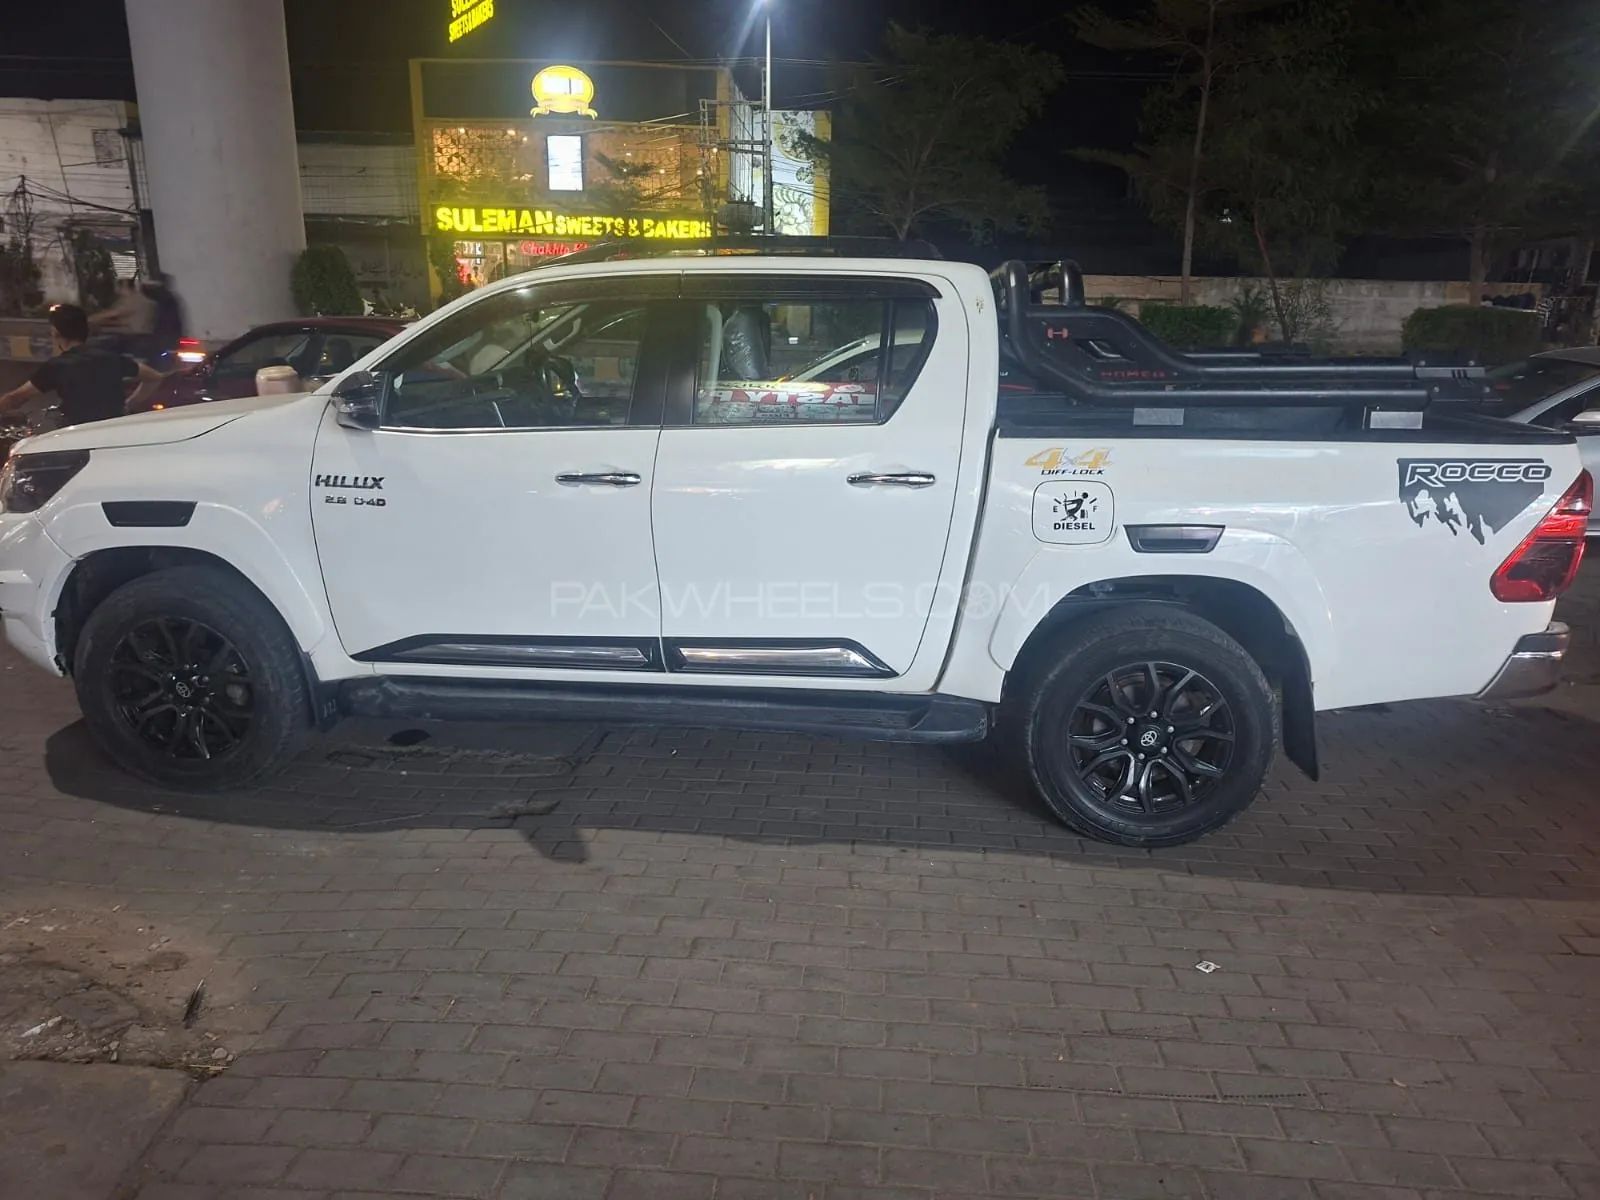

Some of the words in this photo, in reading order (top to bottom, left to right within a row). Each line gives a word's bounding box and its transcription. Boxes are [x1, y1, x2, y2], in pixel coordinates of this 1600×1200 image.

[436, 206, 554, 235] SULEMAN
[555, 215, 625, 236] SWEETS
[628, 219, 640, 237] &
[643, 219, 711, 238] BAKERS
[315, 474, 385, 490] HILUX
[1405, 463, 1552, 487] ROCCO
[354, 497, 387, 506] D-4D
[1053, 522, 1096, 530] DIESEL
